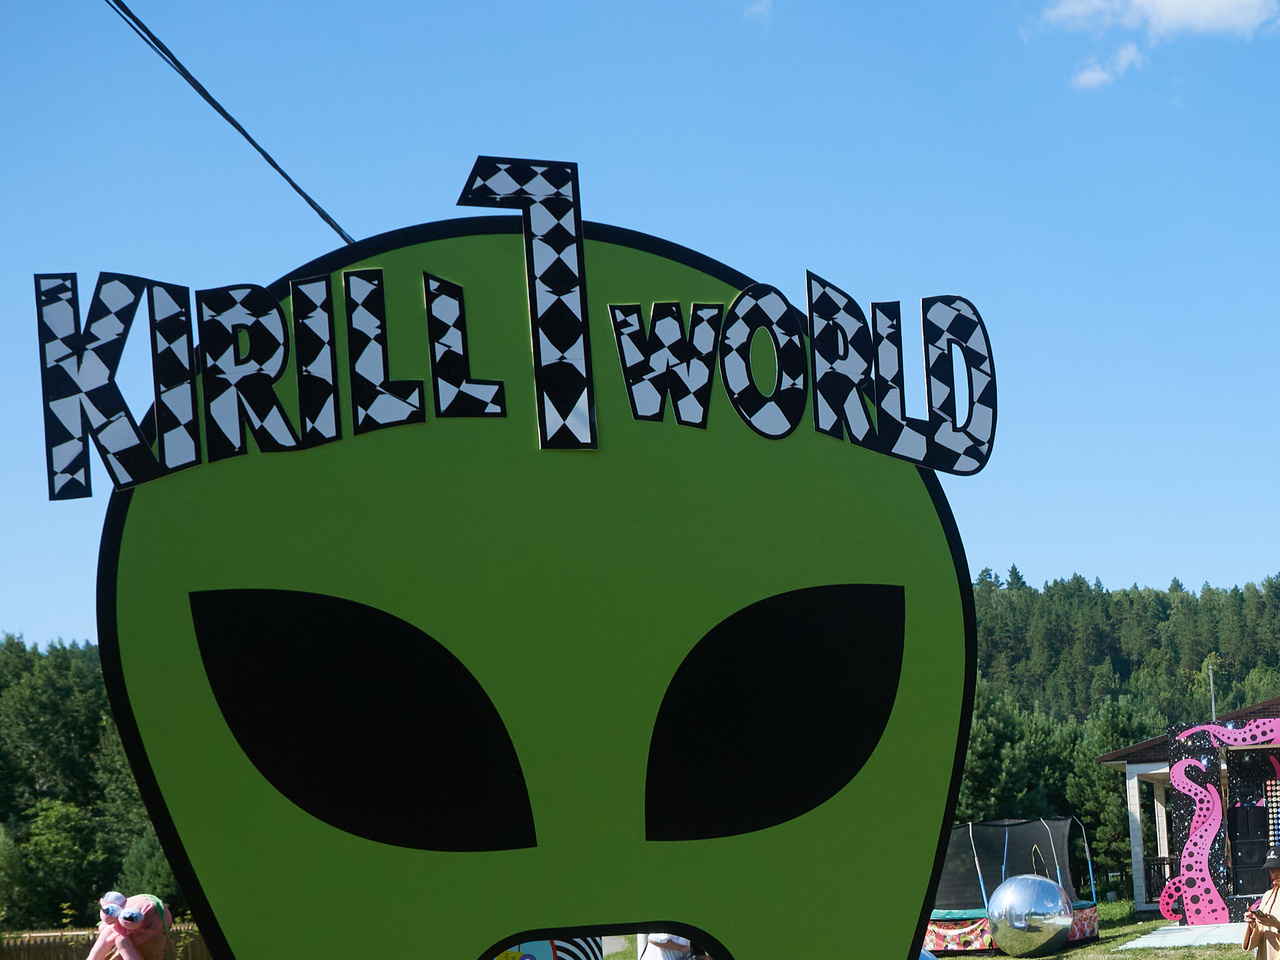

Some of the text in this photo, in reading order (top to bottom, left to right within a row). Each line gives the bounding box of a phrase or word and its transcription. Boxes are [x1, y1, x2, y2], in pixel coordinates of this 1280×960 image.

[33, 154, 999, 502] KIRILL 1 WORLD
